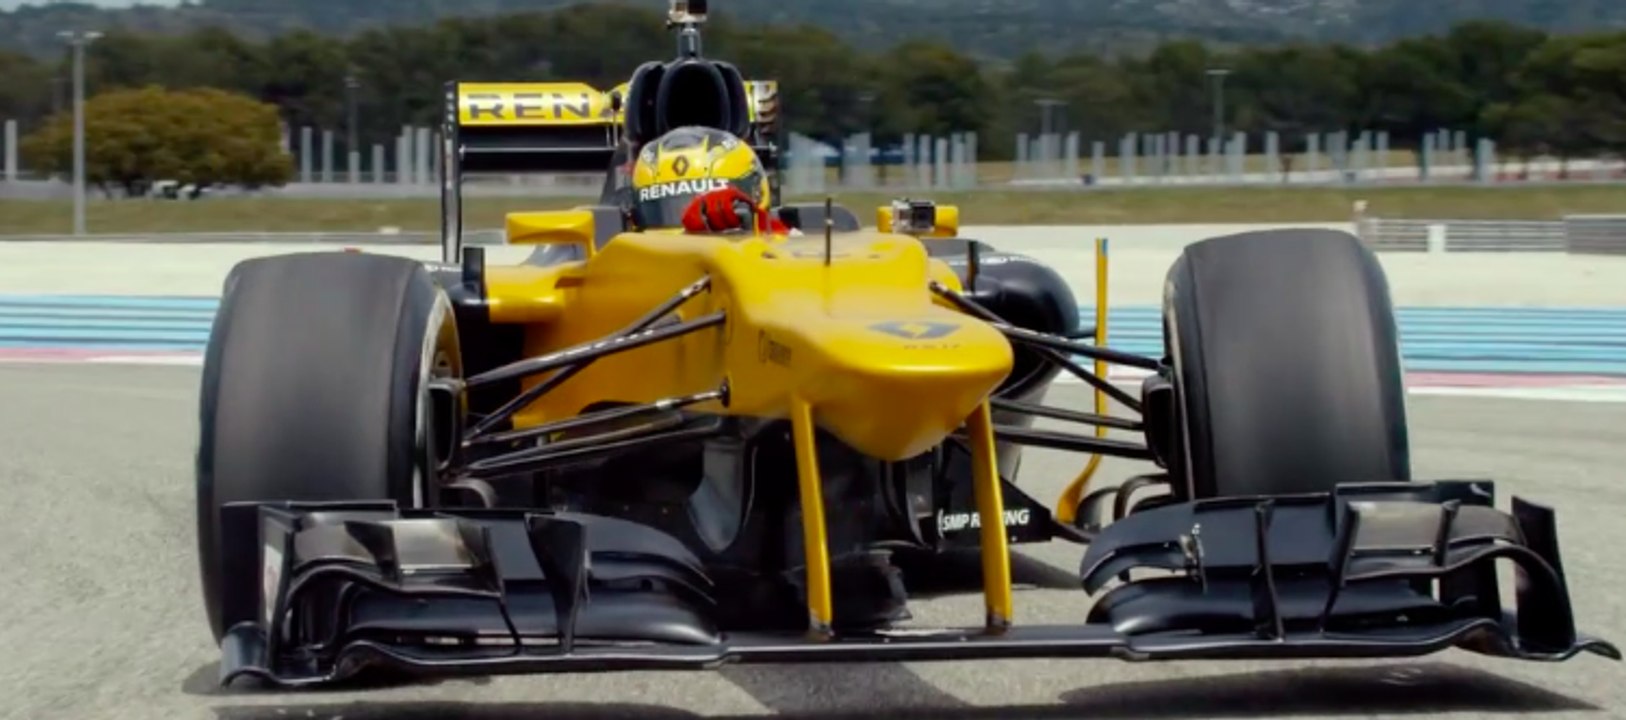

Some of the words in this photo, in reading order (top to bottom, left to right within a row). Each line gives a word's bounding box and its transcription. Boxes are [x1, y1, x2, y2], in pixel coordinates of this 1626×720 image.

[639, 178, 730, 202] RENAULT
[943, 511, 969, 531] SMP
[970, 508, 1030, 528] RNG
